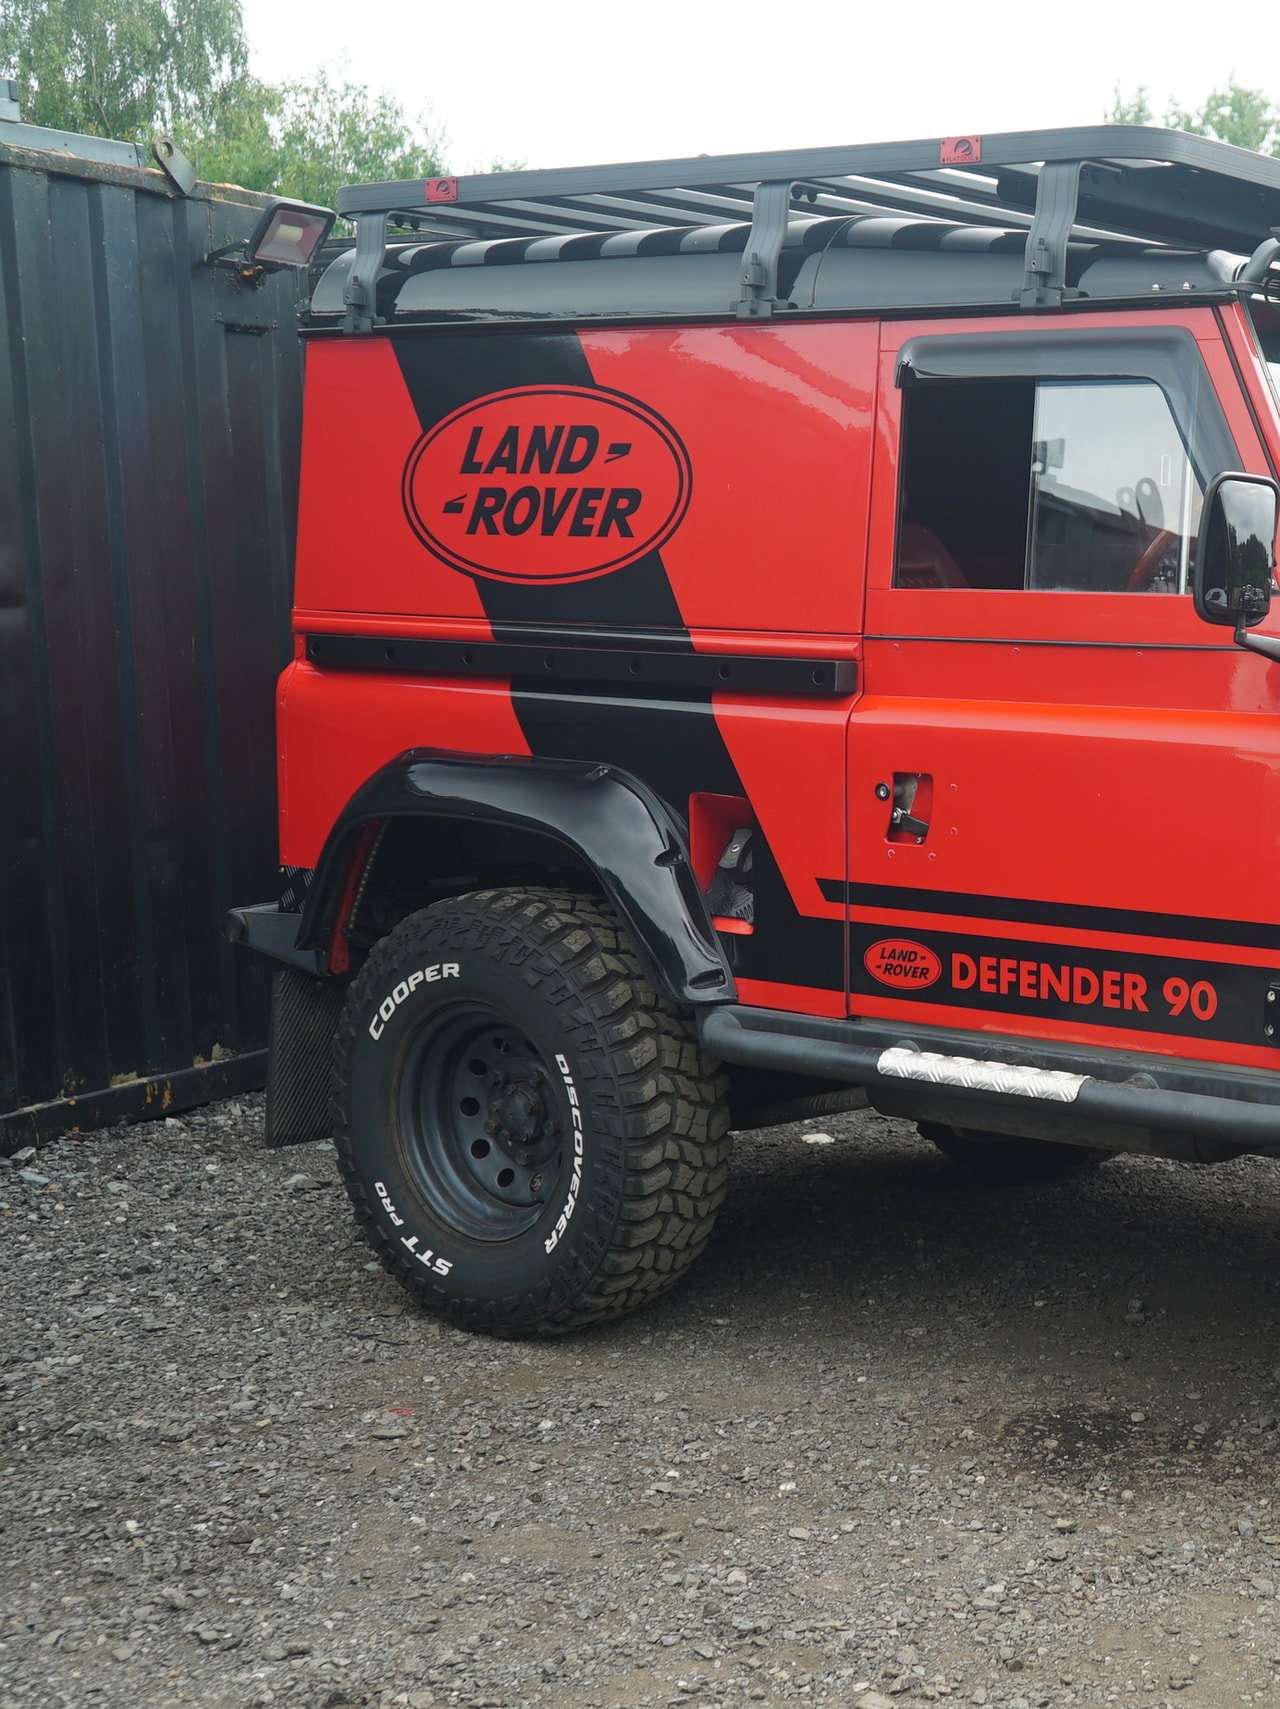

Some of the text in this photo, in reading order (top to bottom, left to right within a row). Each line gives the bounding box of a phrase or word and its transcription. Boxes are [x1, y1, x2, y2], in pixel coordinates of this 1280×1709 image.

[369, 962, 460, 1041] COOPER
[951, 952, 1218, 1021] DEFENDER 90
[544, 1053, 584, 1255] DISCOVERER
[374, 1181, 454, 1277] STT PRO
